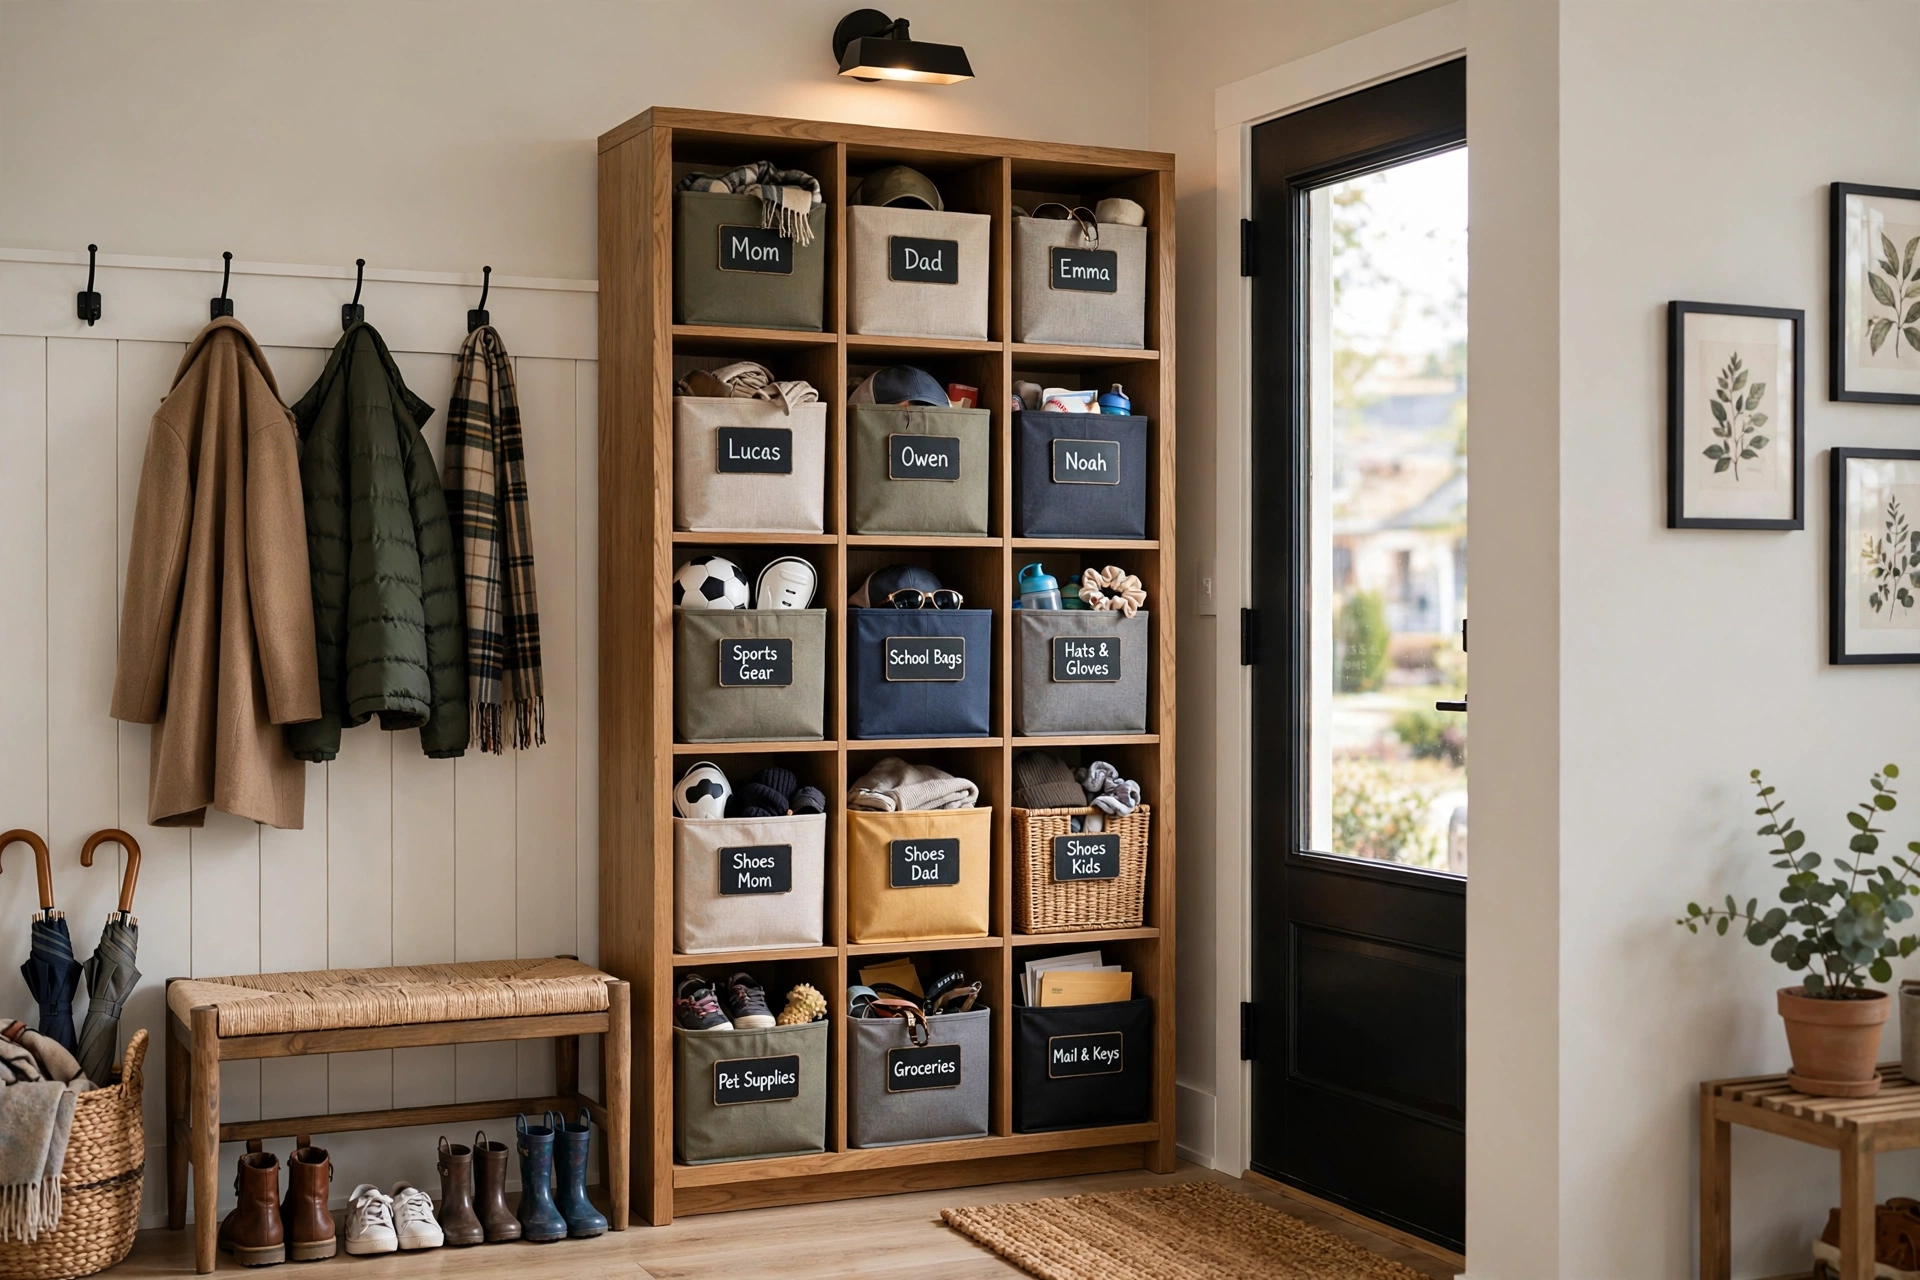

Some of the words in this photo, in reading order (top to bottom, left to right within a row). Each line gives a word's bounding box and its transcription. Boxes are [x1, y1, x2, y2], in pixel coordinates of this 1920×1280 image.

[732, 236, 780, 262] Mom
[904, 248, 943, 272] Dad
[1060, 259, 1111, 281] Emma
[729, 437, 781, 461] Lucas
[902, 445, 949, 468] Owen
[1066, 451, 1107, 472] Noah
[732, 644, 778, 665] Sports
[889, 648, 930, 665] School
[933, 648, 963, 670] Bags
[1064, 641, 1096, 659] Hats
[1098, 642, 1110, 658] &
[739, 664, 774, 680] Gear
[1065, 659, 1109, 676] Gloves
[904, 845, 945, 862] Shoes
[1066, 840, 1106, 857] Shoes
[732, 852, 775, 870] Shoes
[1072, 857, 1101, 875] Kids
[738, 870, 772, 889] Mom
[911, 863, 939, 881] Dad
[1053, 1047, 1078, 1064] Mail
[1080, 1047, 1090, 1062] &
[1093, 1046, 1120, 1065] Keys
[894, 1059, 956, 1078] Groceries
[718, 1072, 741, 1090] Pet
[743, 1069, 796, 1092] Supplies
